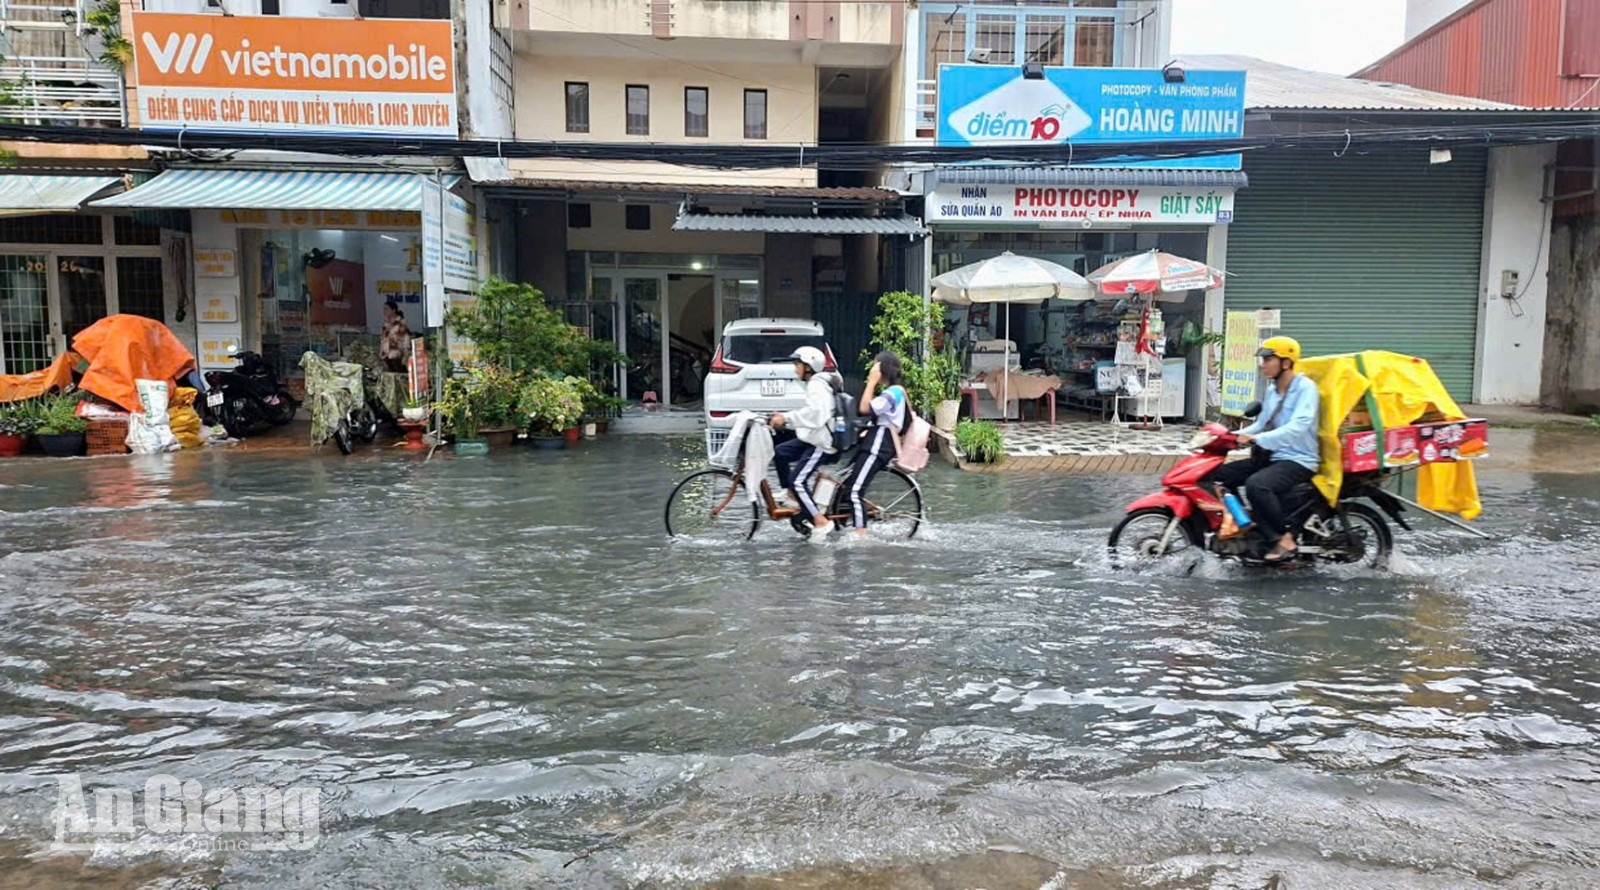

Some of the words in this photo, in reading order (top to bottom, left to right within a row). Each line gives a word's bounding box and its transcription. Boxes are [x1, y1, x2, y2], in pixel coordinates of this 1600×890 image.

[221, 38, 446, 80] vietnamobile
[1102, 84, 1152, 96] PHOTOCOPY
[183, 98, 217, 121] CUNG
[378, 103, 408, 126] LONG
[1101, 101, 1174, 132] HOÀNG
[1182, 109, 1238, 133] MINH
[1030, 117, 1060, 140] 10
[1015, 188, 1139, 207] PHOTOCOPY
[1161, 191, 1191, 217] GIẶT
[1195, 190, 1222, 214] SẤY
[1014, 209, 1027, 217] IN
